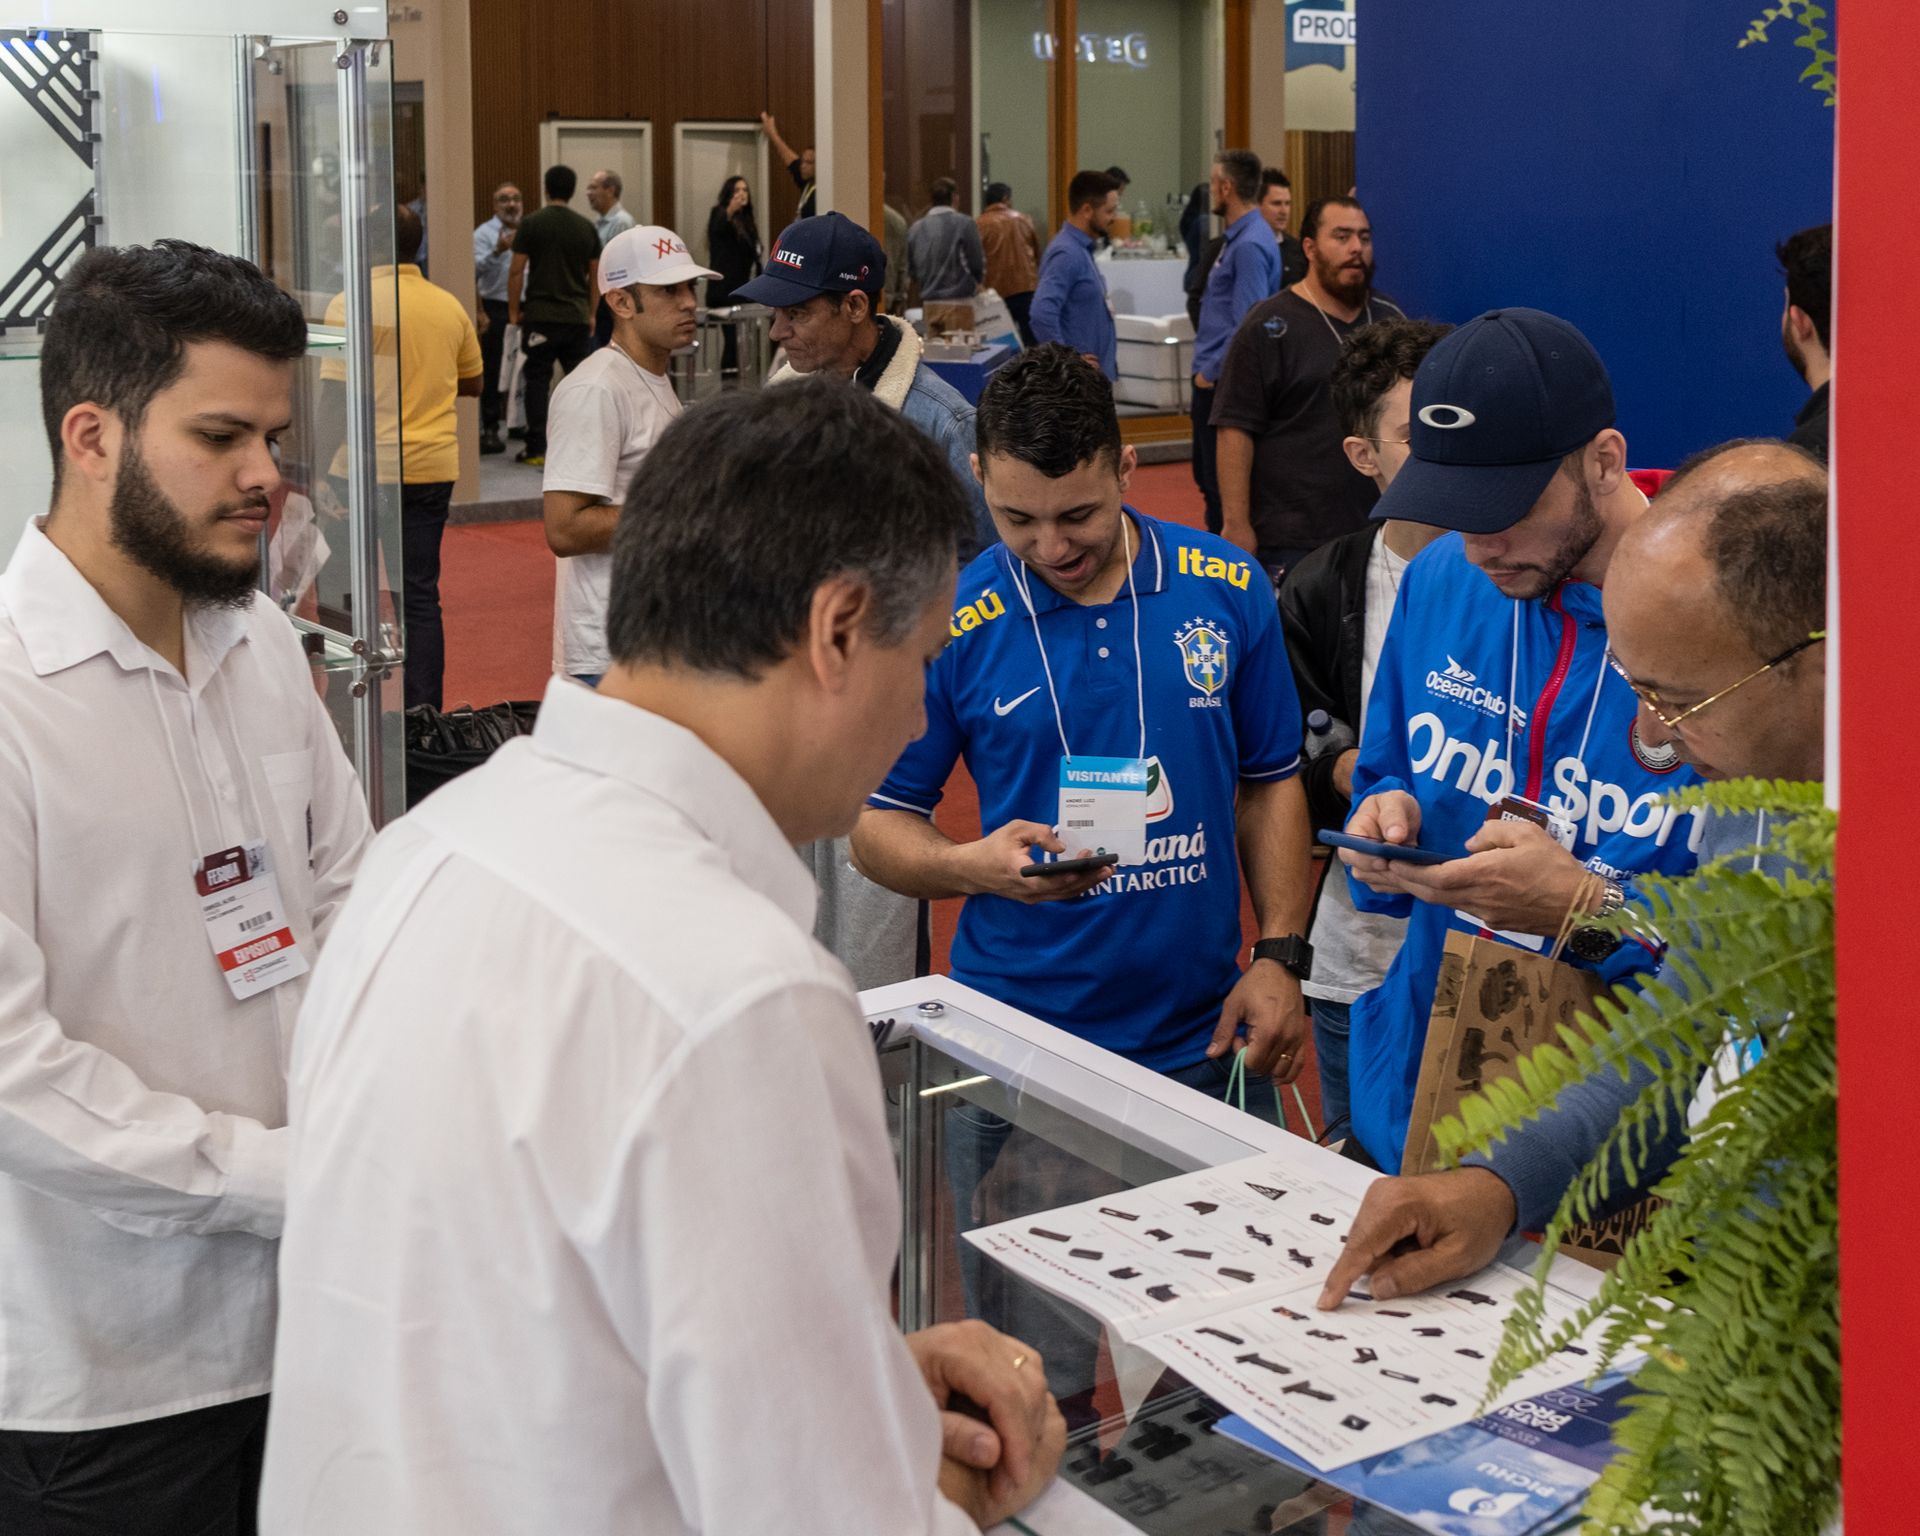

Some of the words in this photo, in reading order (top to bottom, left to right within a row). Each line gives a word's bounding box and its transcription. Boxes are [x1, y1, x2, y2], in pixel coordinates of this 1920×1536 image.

[1178, 546, 1251, 591] Itaú
[948, 588, 1006, 641] taú
[1197, 653, 1215, 663] CBF
[1189, 697, 1222, 708] BRASIL
[1425, 670, 1507, 715] OceanClub
[1066, 770, 1140, 784] VISITANTE
[1476, 1461, 1556, 1498] PICHU
